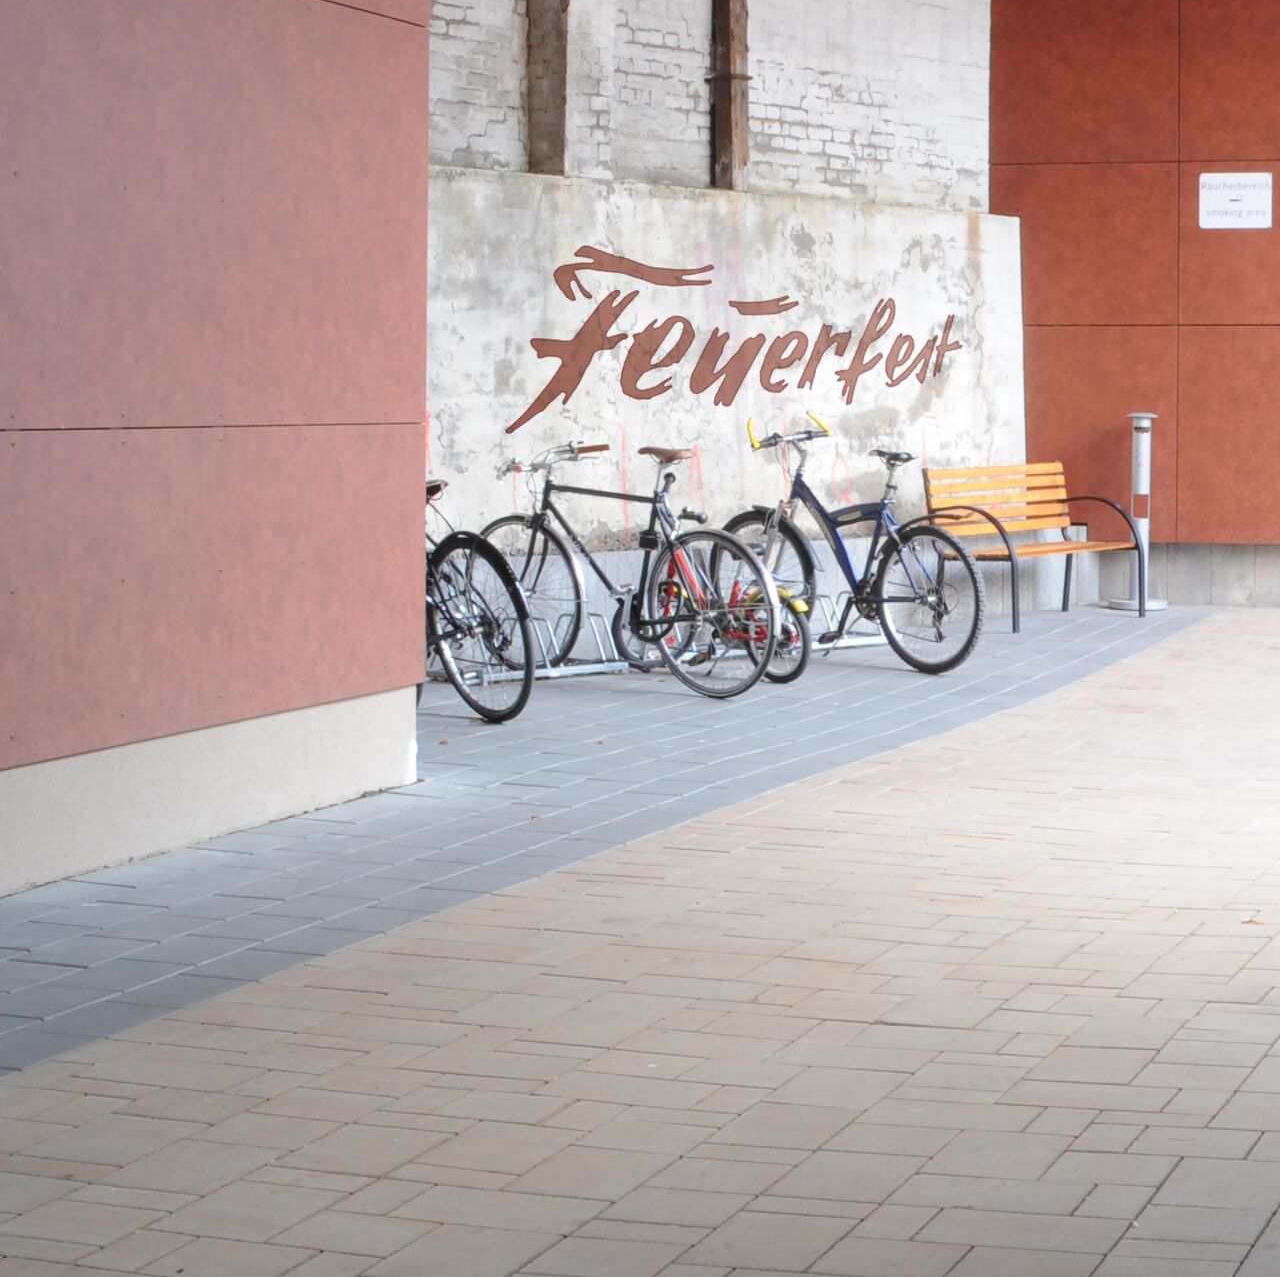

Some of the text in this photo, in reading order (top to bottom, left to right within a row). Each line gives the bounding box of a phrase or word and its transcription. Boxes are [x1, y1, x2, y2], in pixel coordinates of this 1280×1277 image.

[1205, 206, 1267, 220] smoking area
[506, 245, 962, 434] Feuerfest
